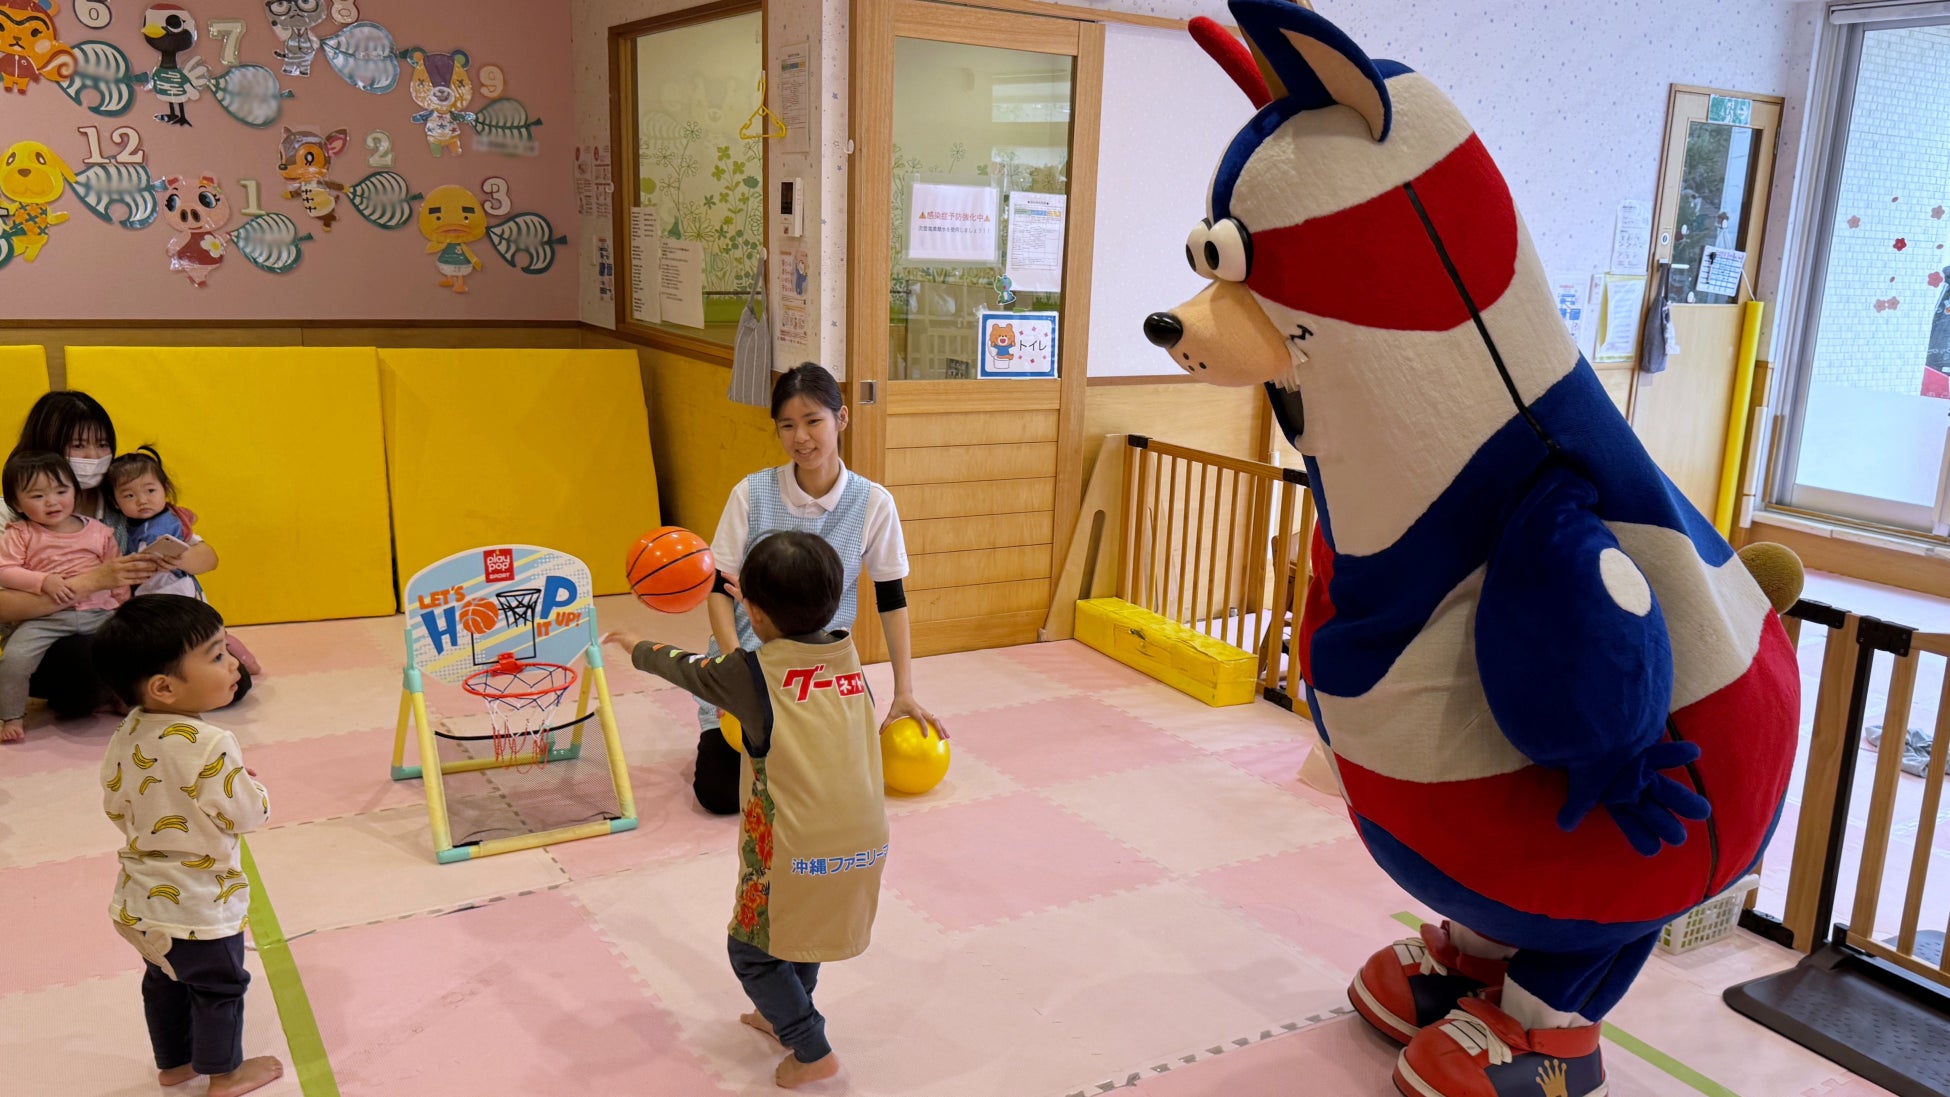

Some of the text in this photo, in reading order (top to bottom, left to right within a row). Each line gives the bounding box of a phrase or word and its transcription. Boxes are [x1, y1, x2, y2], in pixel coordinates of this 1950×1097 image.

[73, 0, 112, 29] 6
[208, 18, 247, 65] 7
[478, 64, 506, 98] 9
[77, 124, 145, 165] 12
[365, 129, 396, 168] 2
[239, 178, 266, 217] 1
[482, 176, 512, 217] 3
[1019, 339, 1047, 351] トイレ
[487, 553, 510, 563] play
[488, 562, 509, 573] pop
[418, 586, 467, 609] LET'S
[536, 612, 582, 637] IT UP!
